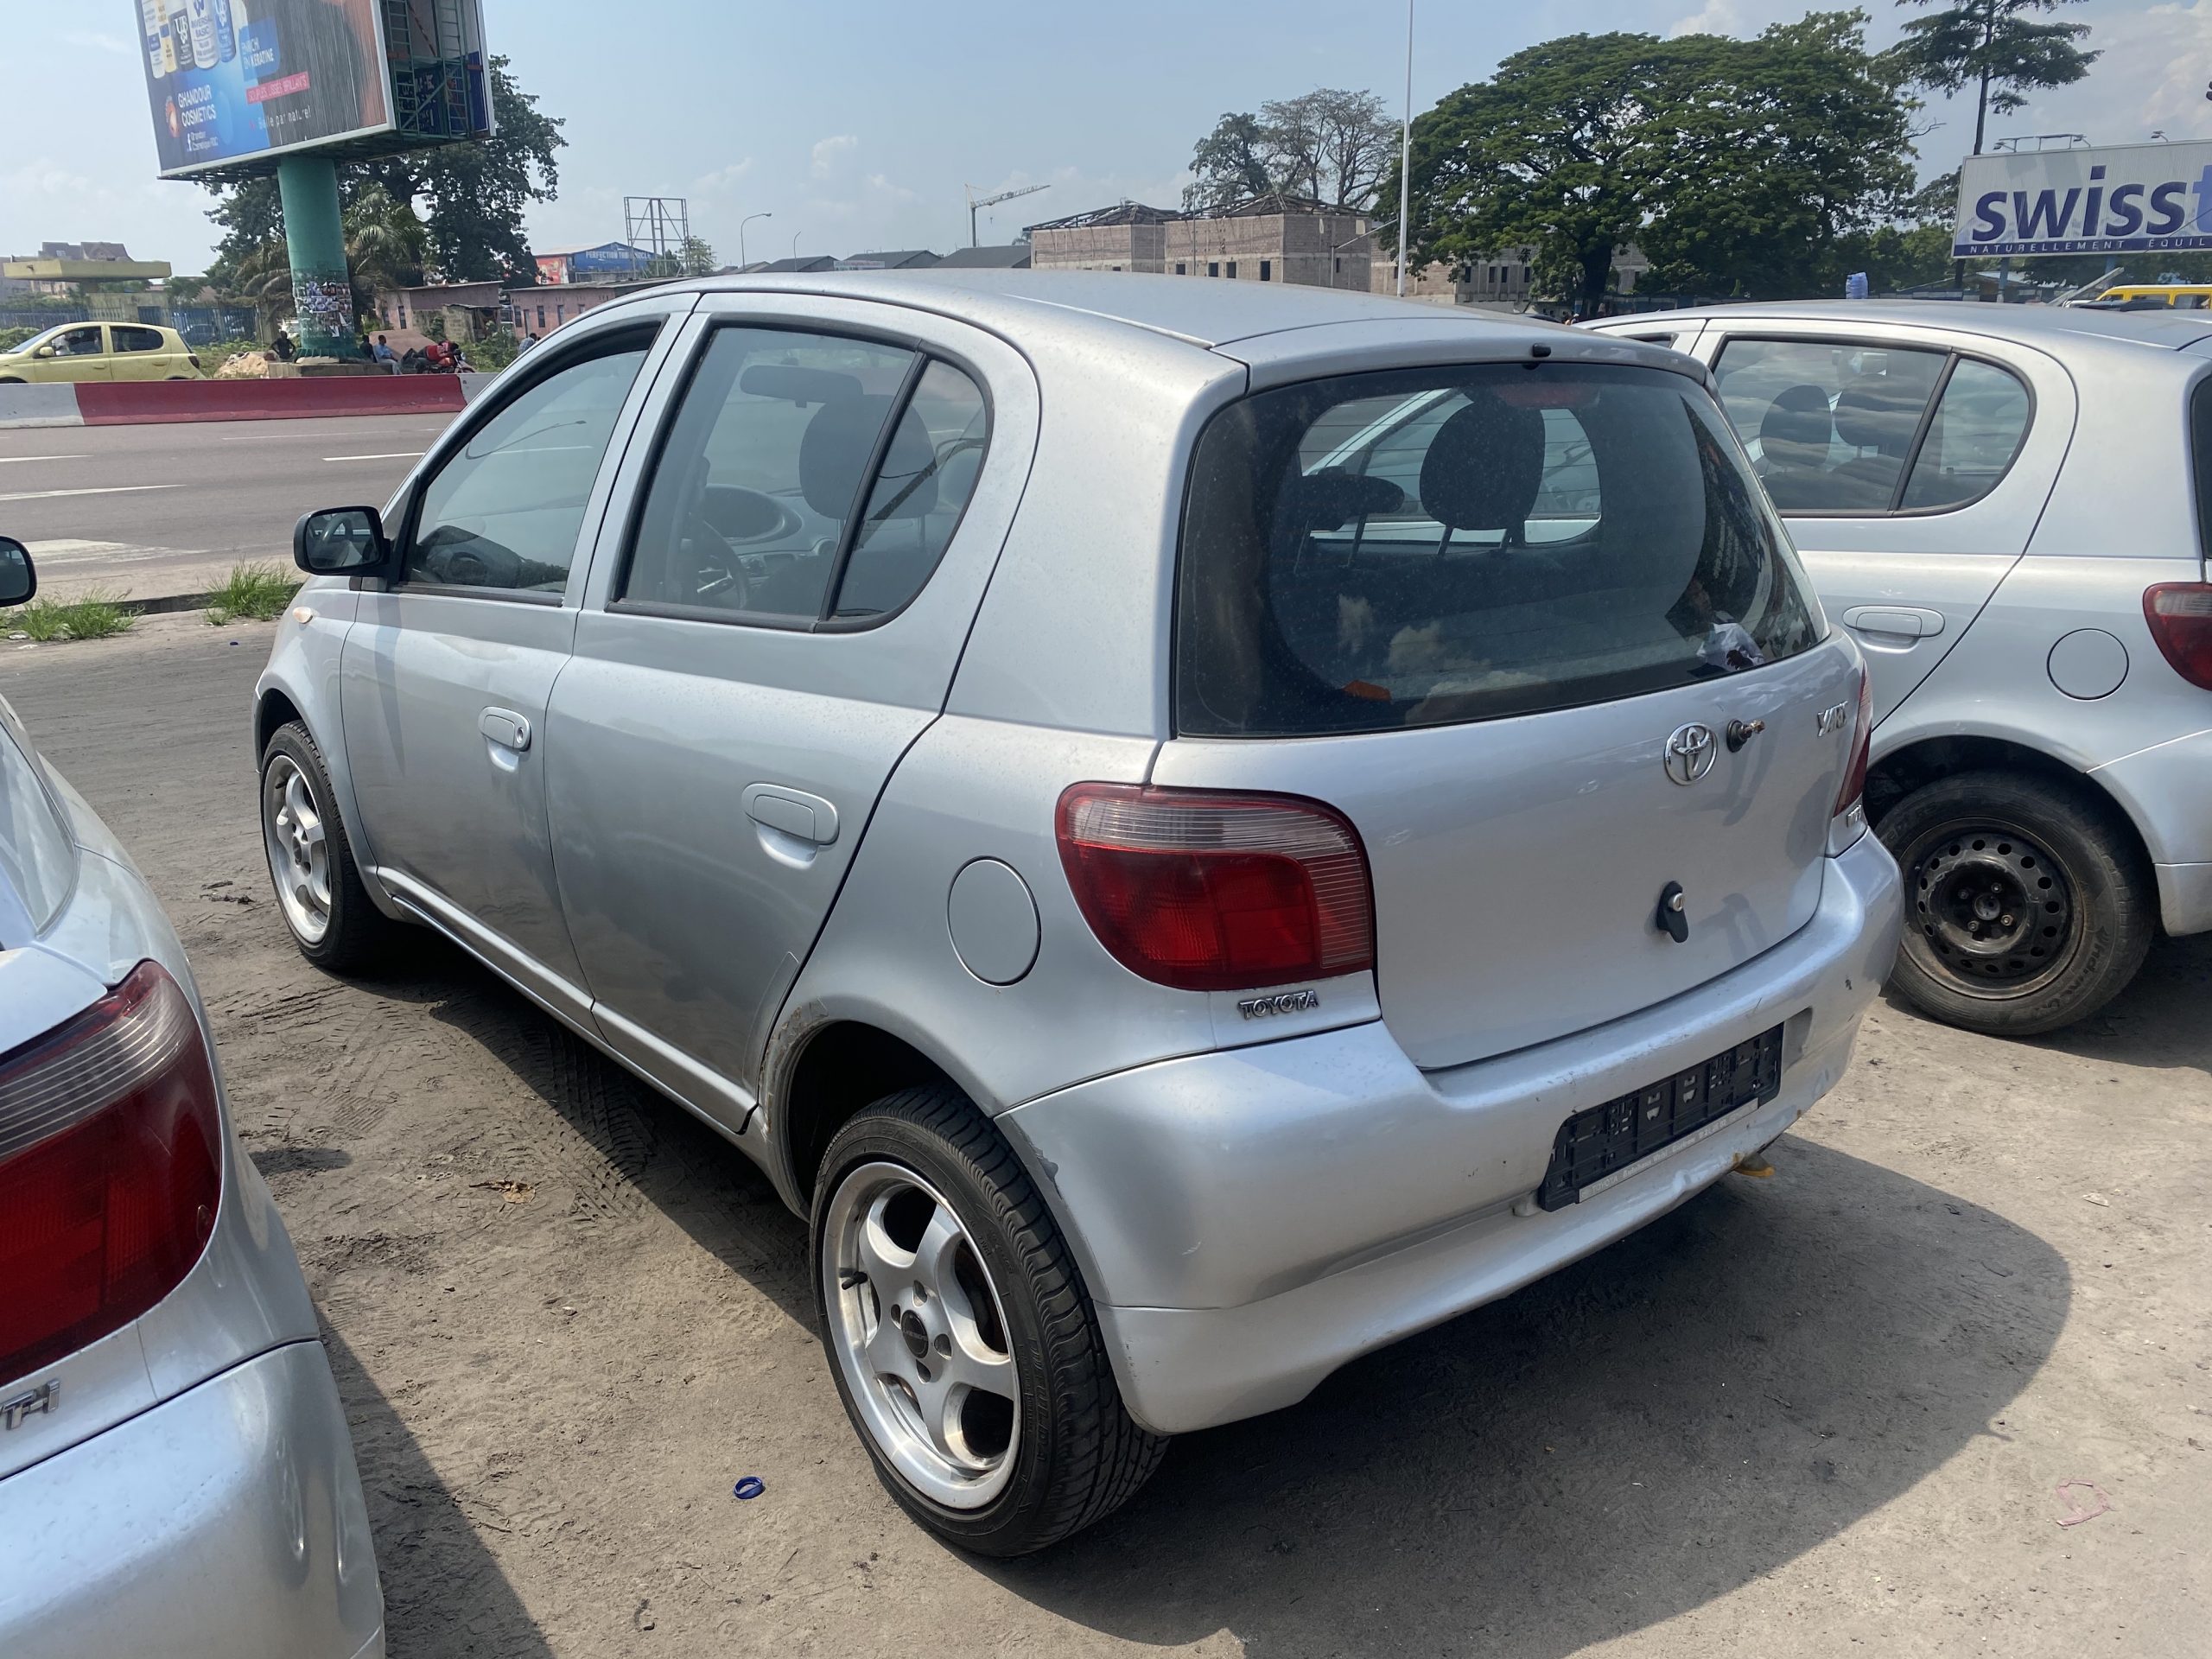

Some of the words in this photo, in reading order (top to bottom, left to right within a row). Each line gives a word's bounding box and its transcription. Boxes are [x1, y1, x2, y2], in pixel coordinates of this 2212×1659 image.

[178, 84, 213, 108] GHANDOUR
[181, 104, 216, 127] COSMETICS
[1969, 239, 2126, 255] NATURELLEMENT
[1238, 990, 1319, 1020] TOYOTA
